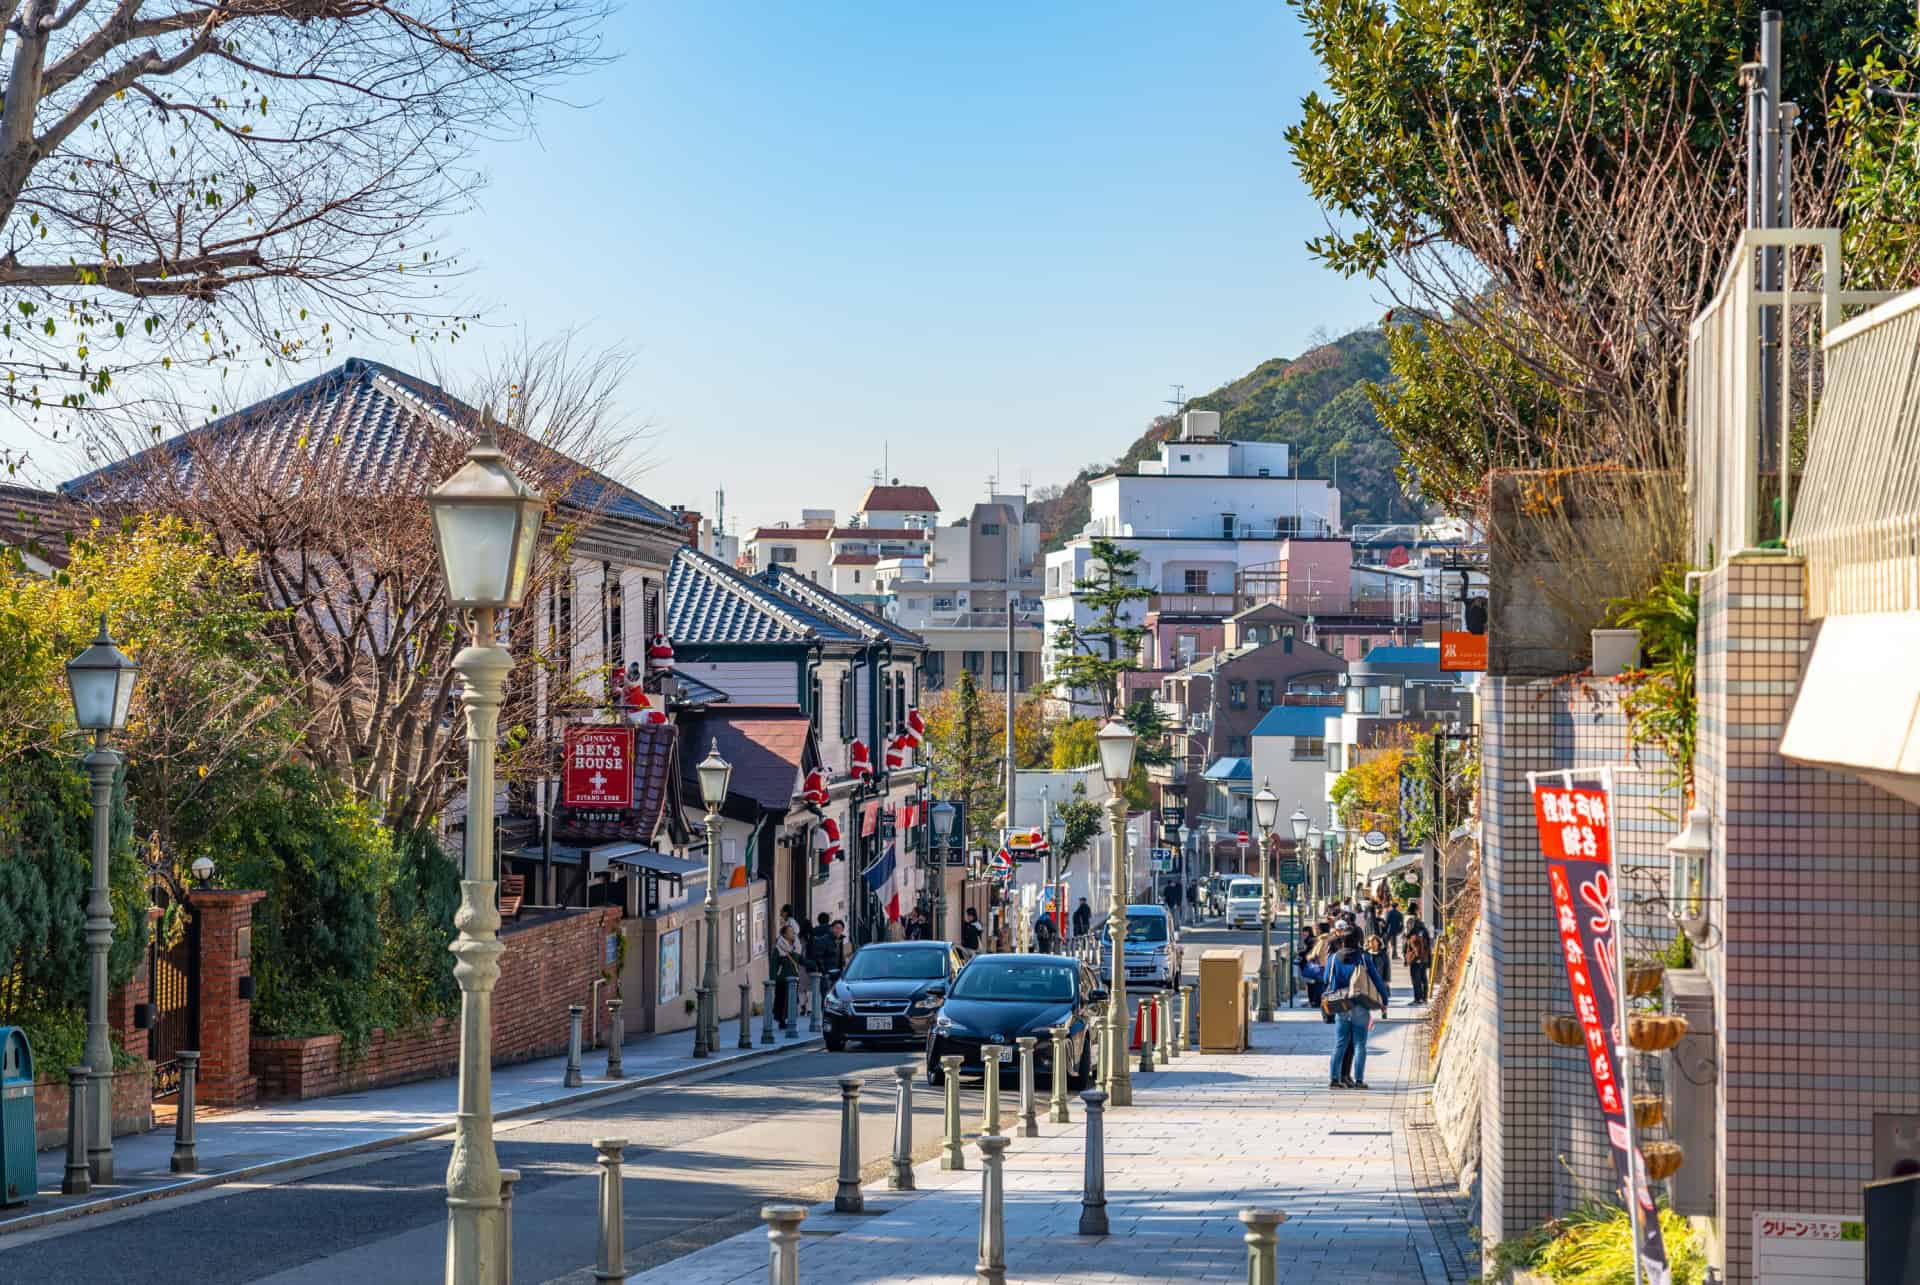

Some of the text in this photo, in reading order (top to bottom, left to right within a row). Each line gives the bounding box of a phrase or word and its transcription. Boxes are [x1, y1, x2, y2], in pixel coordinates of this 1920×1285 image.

[575, 743, 621, 757] BEN'S
[575, 757, 623, 769] HOUSE
[1762, 1220, 1809, 1237] クリーン
